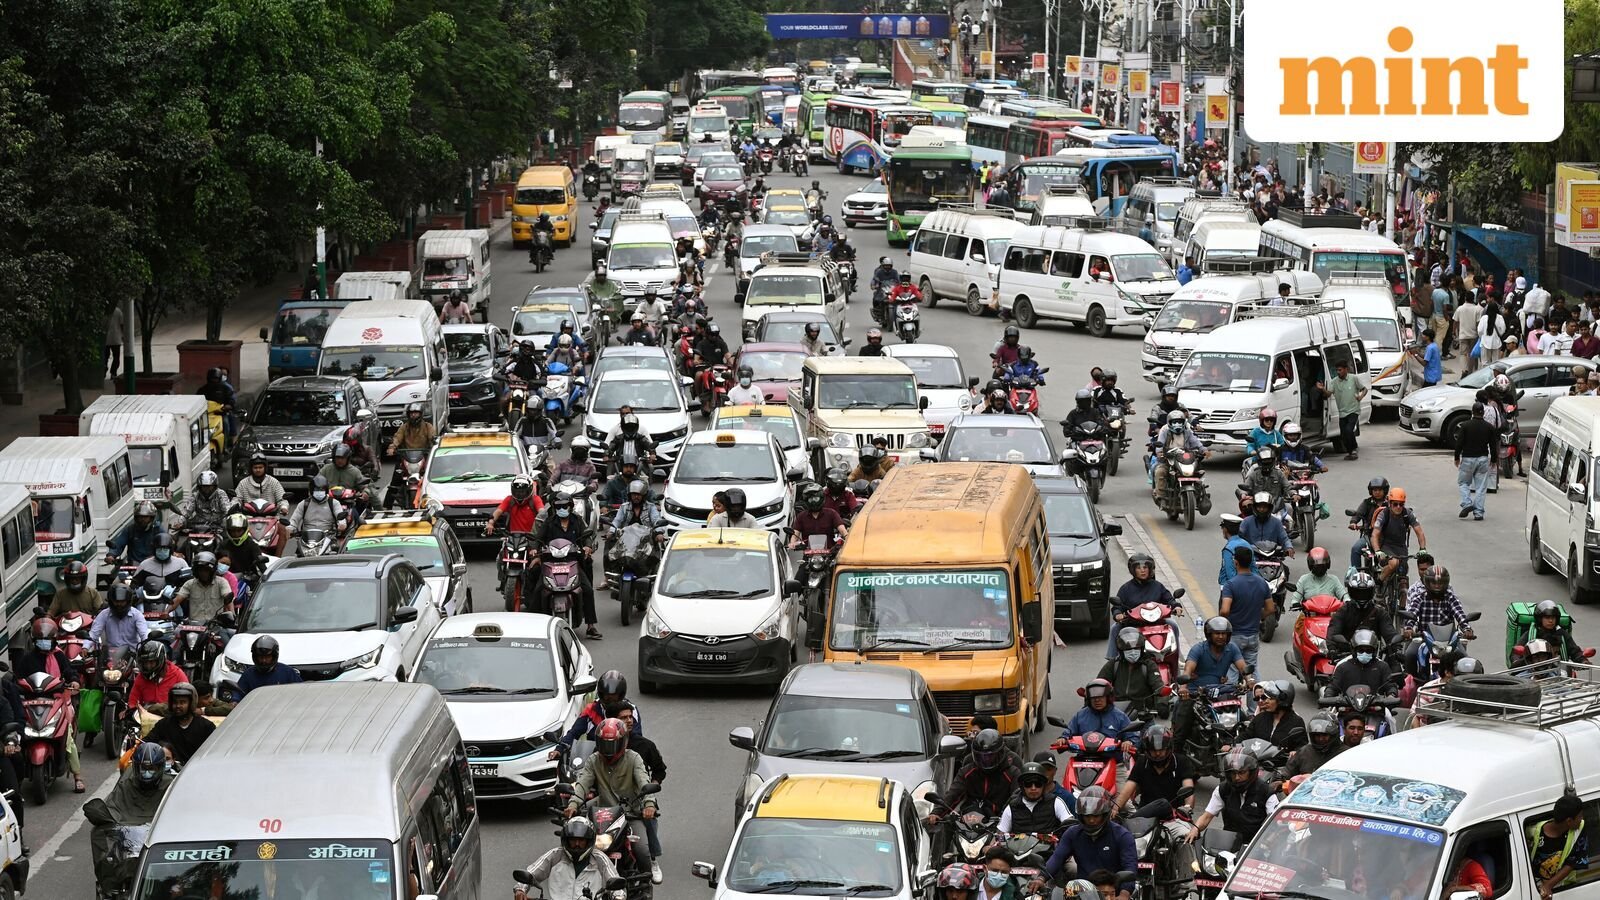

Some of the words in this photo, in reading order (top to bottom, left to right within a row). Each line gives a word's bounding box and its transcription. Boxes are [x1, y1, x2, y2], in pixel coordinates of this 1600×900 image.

[1023, 166, 1080, 176] TOURIST
[848, 572, 905, 588] थानकोट
[906, 574, 940, 586] नगर
[940, 573, 1001, 586] यातायात
[477, 626, 498, 634] TAXI
[1363, 820, 1398, 833] यातायात
[164, 845, 233, 861] बाराही
[308, 843, 378, 859] अजिमा
